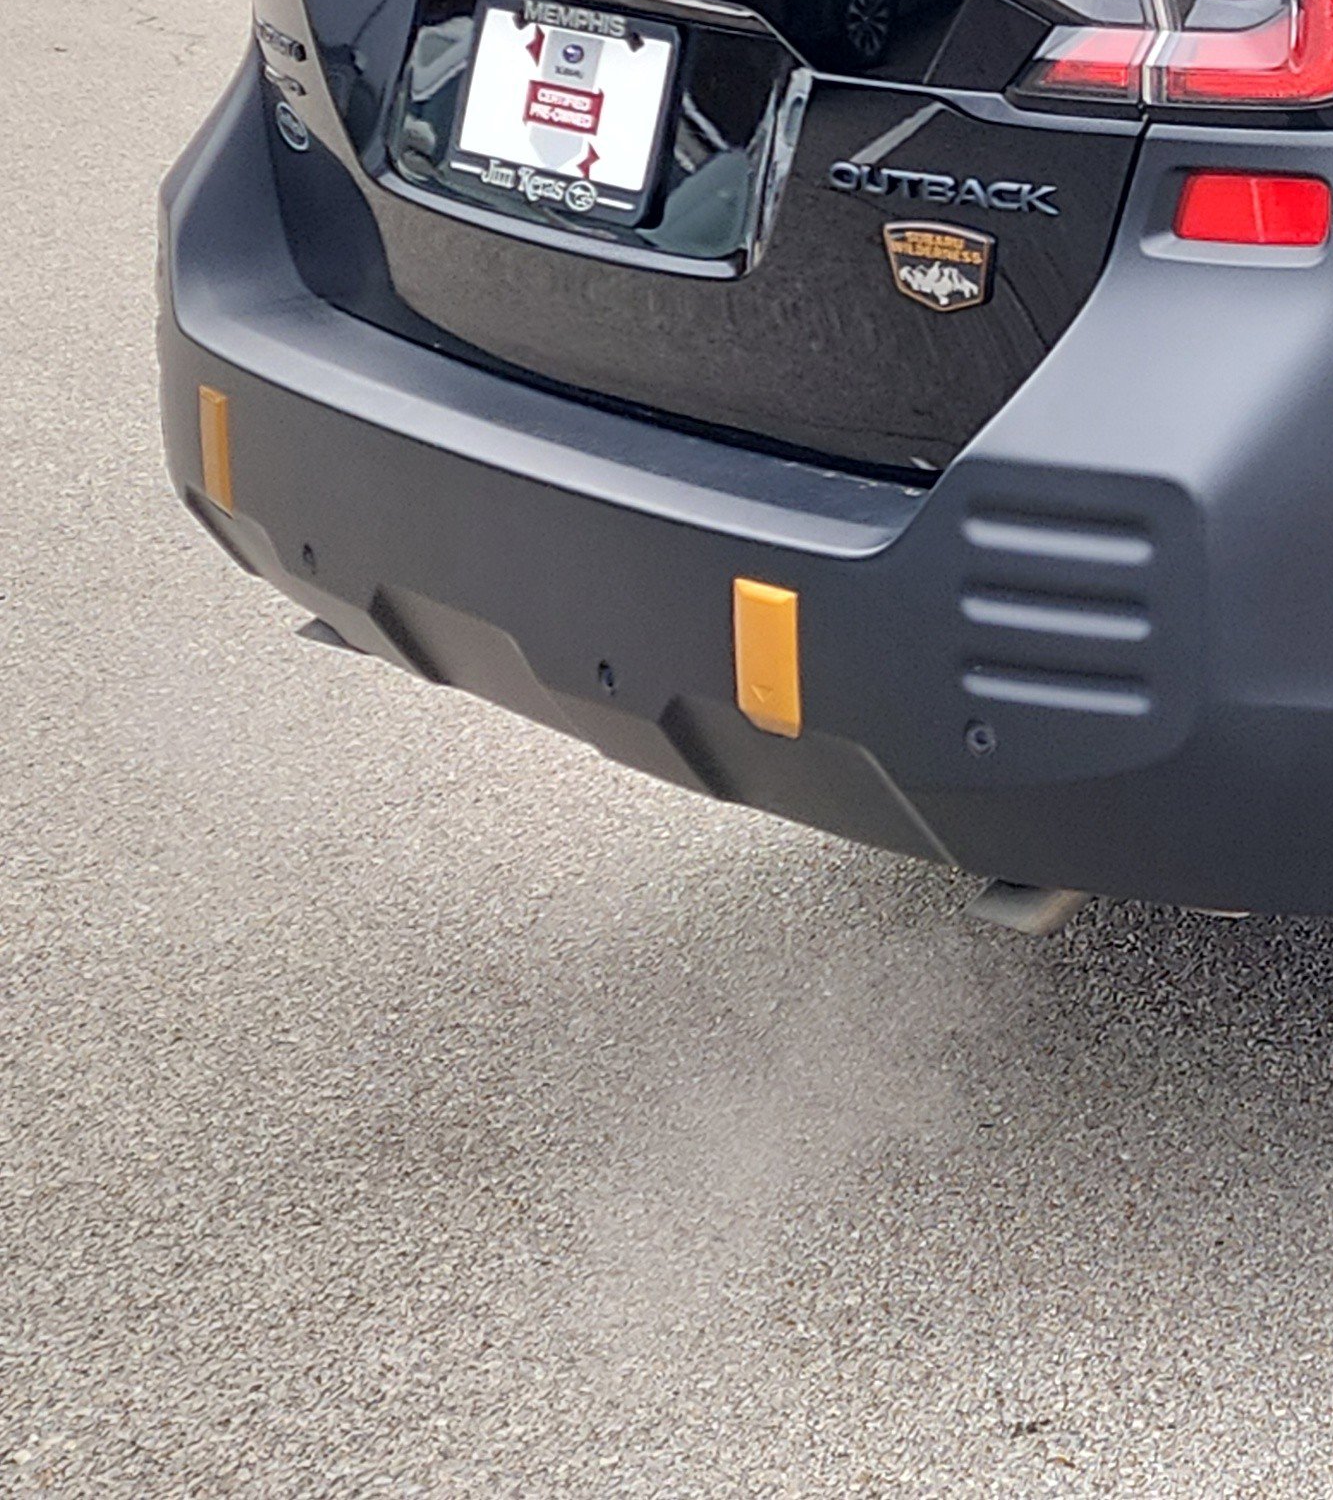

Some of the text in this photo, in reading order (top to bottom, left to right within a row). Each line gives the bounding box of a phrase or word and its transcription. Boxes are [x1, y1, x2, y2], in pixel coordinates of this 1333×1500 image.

[522, 0, 628, 38] MEMPHIS
[480, 158, 516, 190] Jim
[828, 160, 1062, 217] OUTBACK
